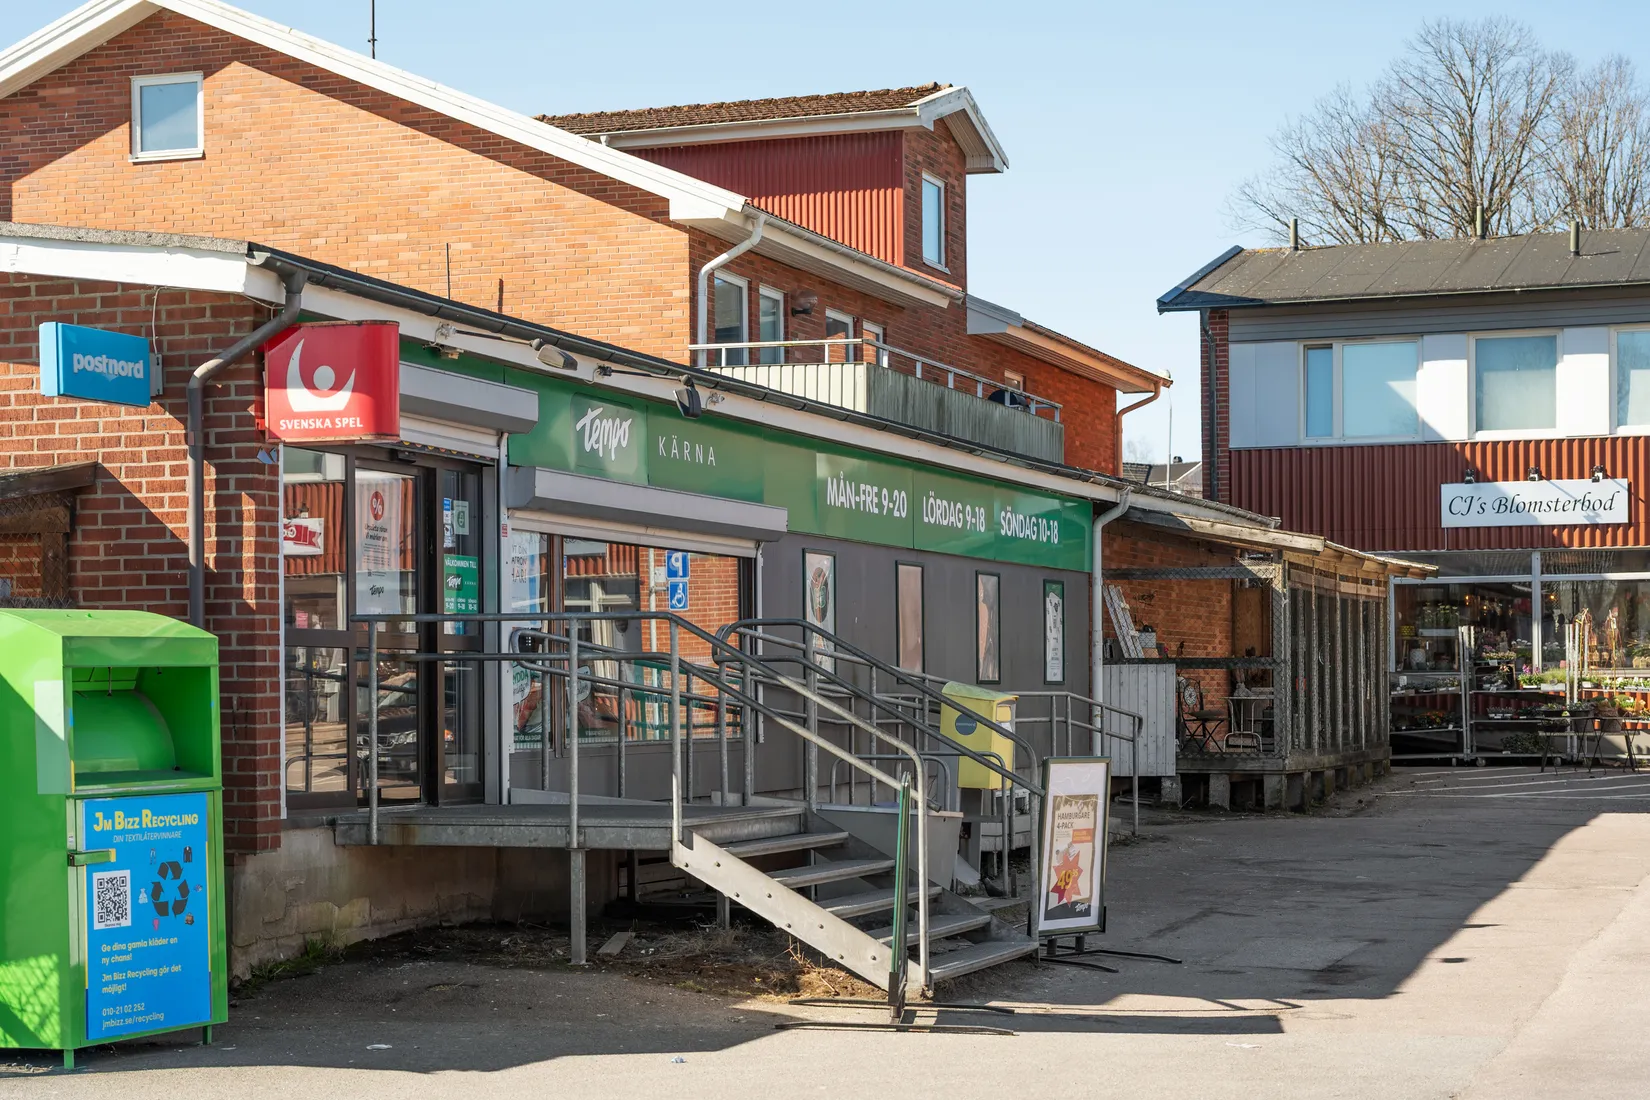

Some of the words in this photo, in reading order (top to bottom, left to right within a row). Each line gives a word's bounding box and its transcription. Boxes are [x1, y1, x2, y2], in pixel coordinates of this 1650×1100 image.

[72, 351, 144, 379] postnord
[279, 419, 333, 430] SVENSKA
[335, 417, 363, 429] SPEL
[658, 435, 716, 466] KÄRNA
[826, 471, 879, 514] MÅN-FRE
[881, 487, 908, 518] 9-20
[1491, 491, 1621, 514] Blomsterbod
[923, 491, 963, 528] LÖRDAG
[965, 505, 986, 532] 9-18
[1000, 506, 1038, 540] SÖNDAG
[1039, 517, 1059, 544] 10-18
[445, 558, 469, 568] VÄLKOMMEN
[114, 810, 140, 830] BIZZ
[141, 808, 199, 829] RECYCLING
[1057, 811, 1090, 820] HAMBURGARE
[1056, 821, 1074, 830] 4-PACK
[113, 834, 124, 843] DIN
[125, 831, 182, 842] TEXTILÅTERVINNARE
[101, 944, 111, 952] Ge
[112, 942, 127, 951] dina
[127, 940, 148, 951] gamla
[148, 937, 169, 946] kläder
[101, 957, 110, 966] ny
[111, 953, 132, 963] chans!
[102, 973, 112, 982] Jm
[113, 971, 126, 981] Bizz
[127, 968, 158, 979] Recycling
[158, 966, 169, 976] gör
[170, 964, 182, 972] det
[102, 982, 127, 995] möjligt!
[102, 1005, 123, 1016] 010-21
[123, 1004, 132, 1013] 02
[133, 1002, 145, 1011] 252
[102, 1012, 165, 1030] jmbizz.se/recycling
